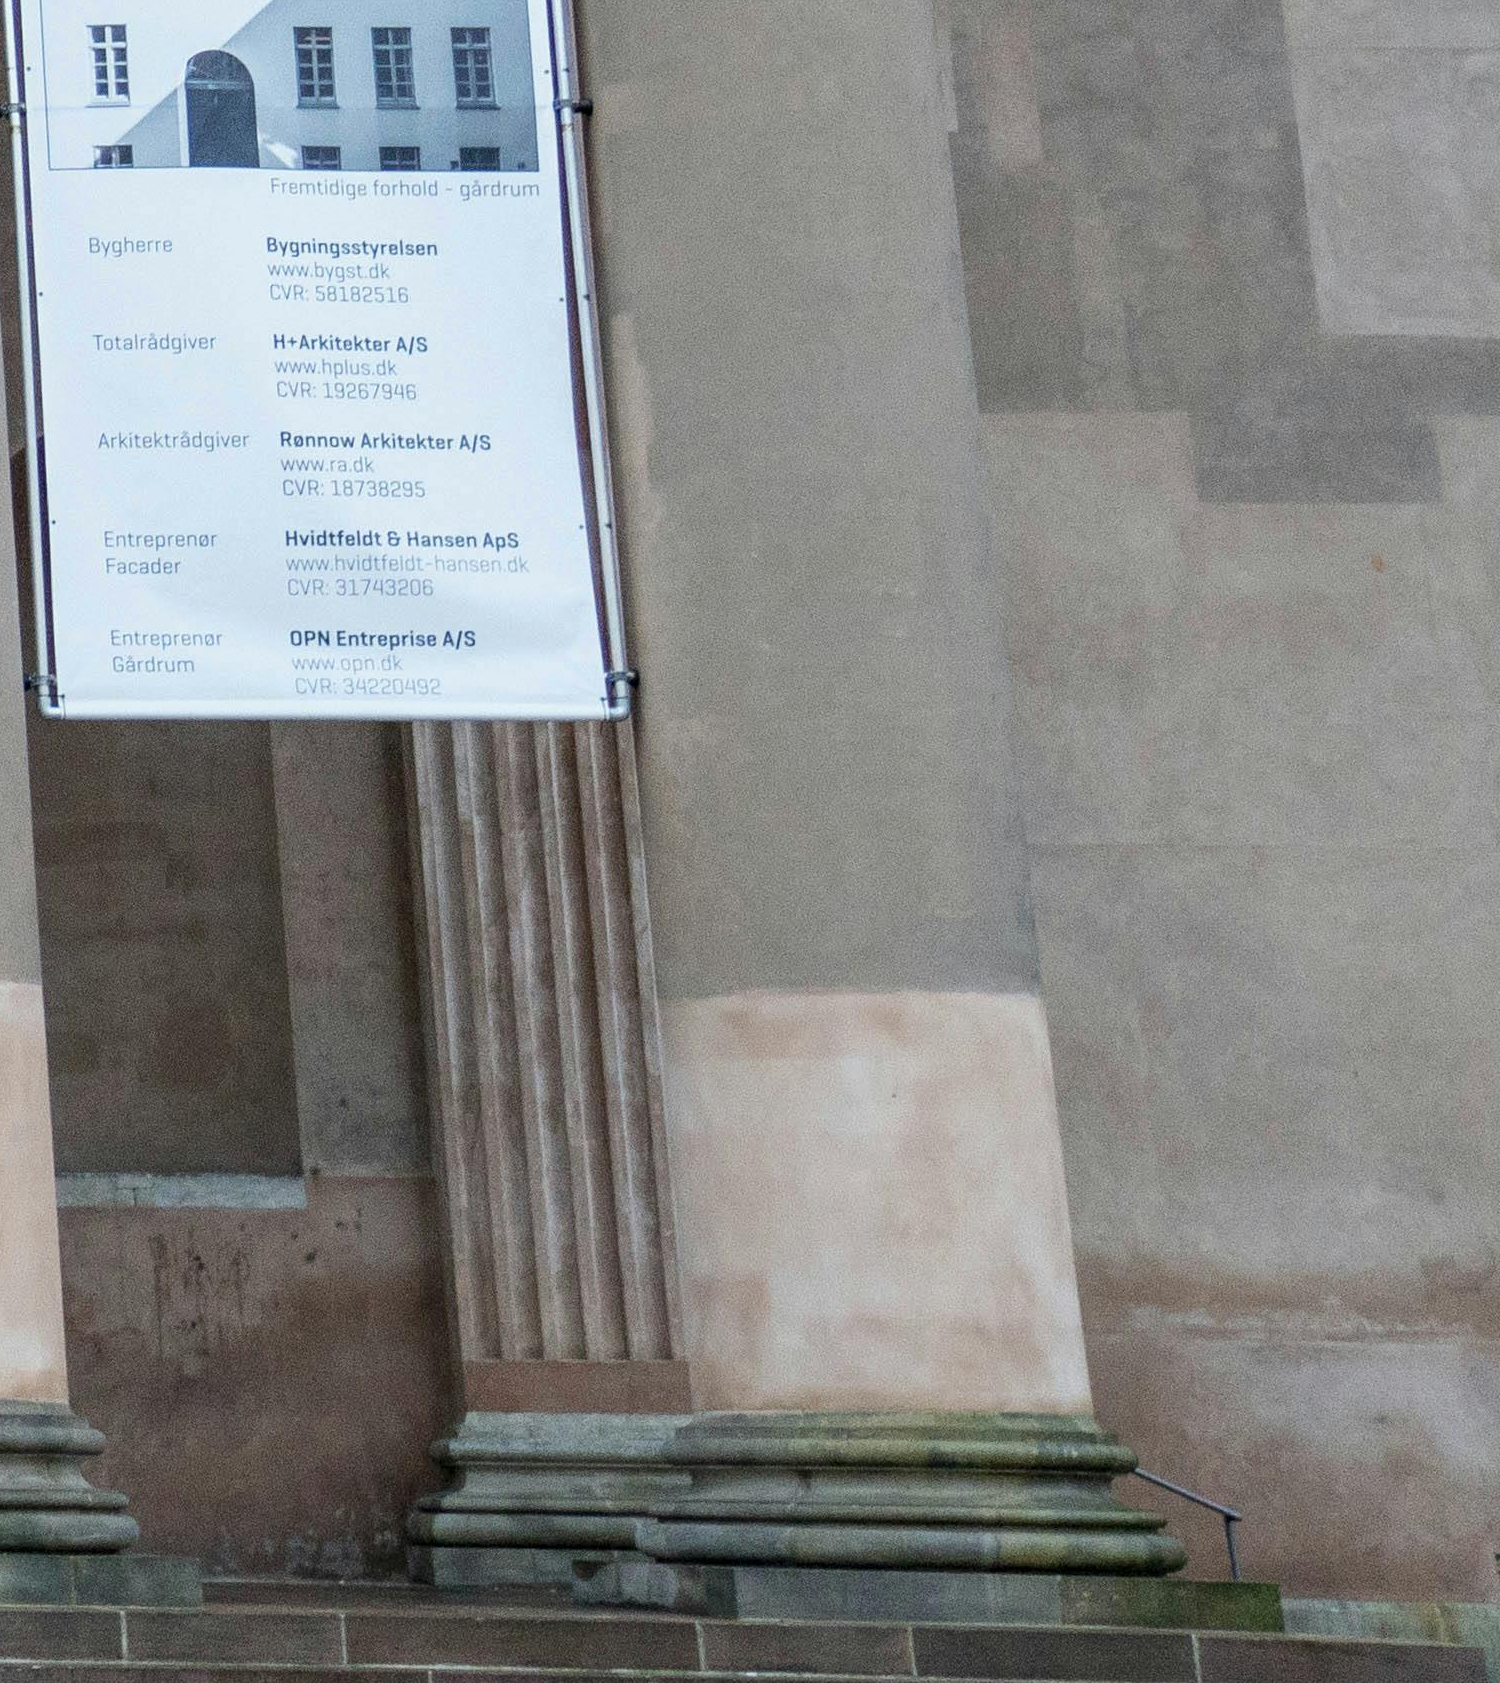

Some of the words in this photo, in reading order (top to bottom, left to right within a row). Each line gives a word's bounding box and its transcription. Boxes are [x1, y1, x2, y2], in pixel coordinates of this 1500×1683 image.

[270, 177, 367, 200] Fremtidige
[373, 179, 439, 198] forhold
[459, 180, 540, 202] gårdrum
[88, 236, 174, 258] Bygherre
[266, 237, 438, 260] Bygningsstyrelsen
[267, 262, 391, 283] www.bygst.dk
[269, 284, 310, 302] CVR:
[314, 285, 409, 304] 58182516
[92, 333, 217, 355] Totalrådgiver
[273, 333, 391, 353] H+Arkitekter
[395, 336, 428, 355] A/S
[274, 358, 398, 380] www.hplus.dk
[276, 381, 317, 399] CVR:
[322, 382, 417, 401] 19267946
[97, 430, 250, 453] Arkitektrådgiver
[280, 431, 355, 449] Rønnow
[359, 432, 453, 451] Arkitekter
[458, 434, 492, 453] A/S
[280, 456, 375, 473] www.ra.dk
[282, 479, 325, 497] CVR:
[330, 479, 426, 499] 18738295
[103, 530, 217, 553] Entreprenør
[285, 530, 383, 548] Hvidtfeldt
[387, 530, 400, 548] &
[407, 531, 478, 549] Hansen
[482, 532, 520, 553] ApS
[105, 557, 182, 575] Facader
[287, 578, 330, 597] CVR:
[335, 578, 434, 597] 31743206
[110, 629, 223, 651] Entreprenør
[290, 630, 331, 647] OPN
[336, 630, 438, 651] Entreprise
[442, 630, 476, 650] A/S
[112, 655, 195, 674] Gårdrum
[291, 654, 404, 676] www.opn.dk
[294, 677, 338, 695] CVR:
[342, 677, 441, 696] 34220492
